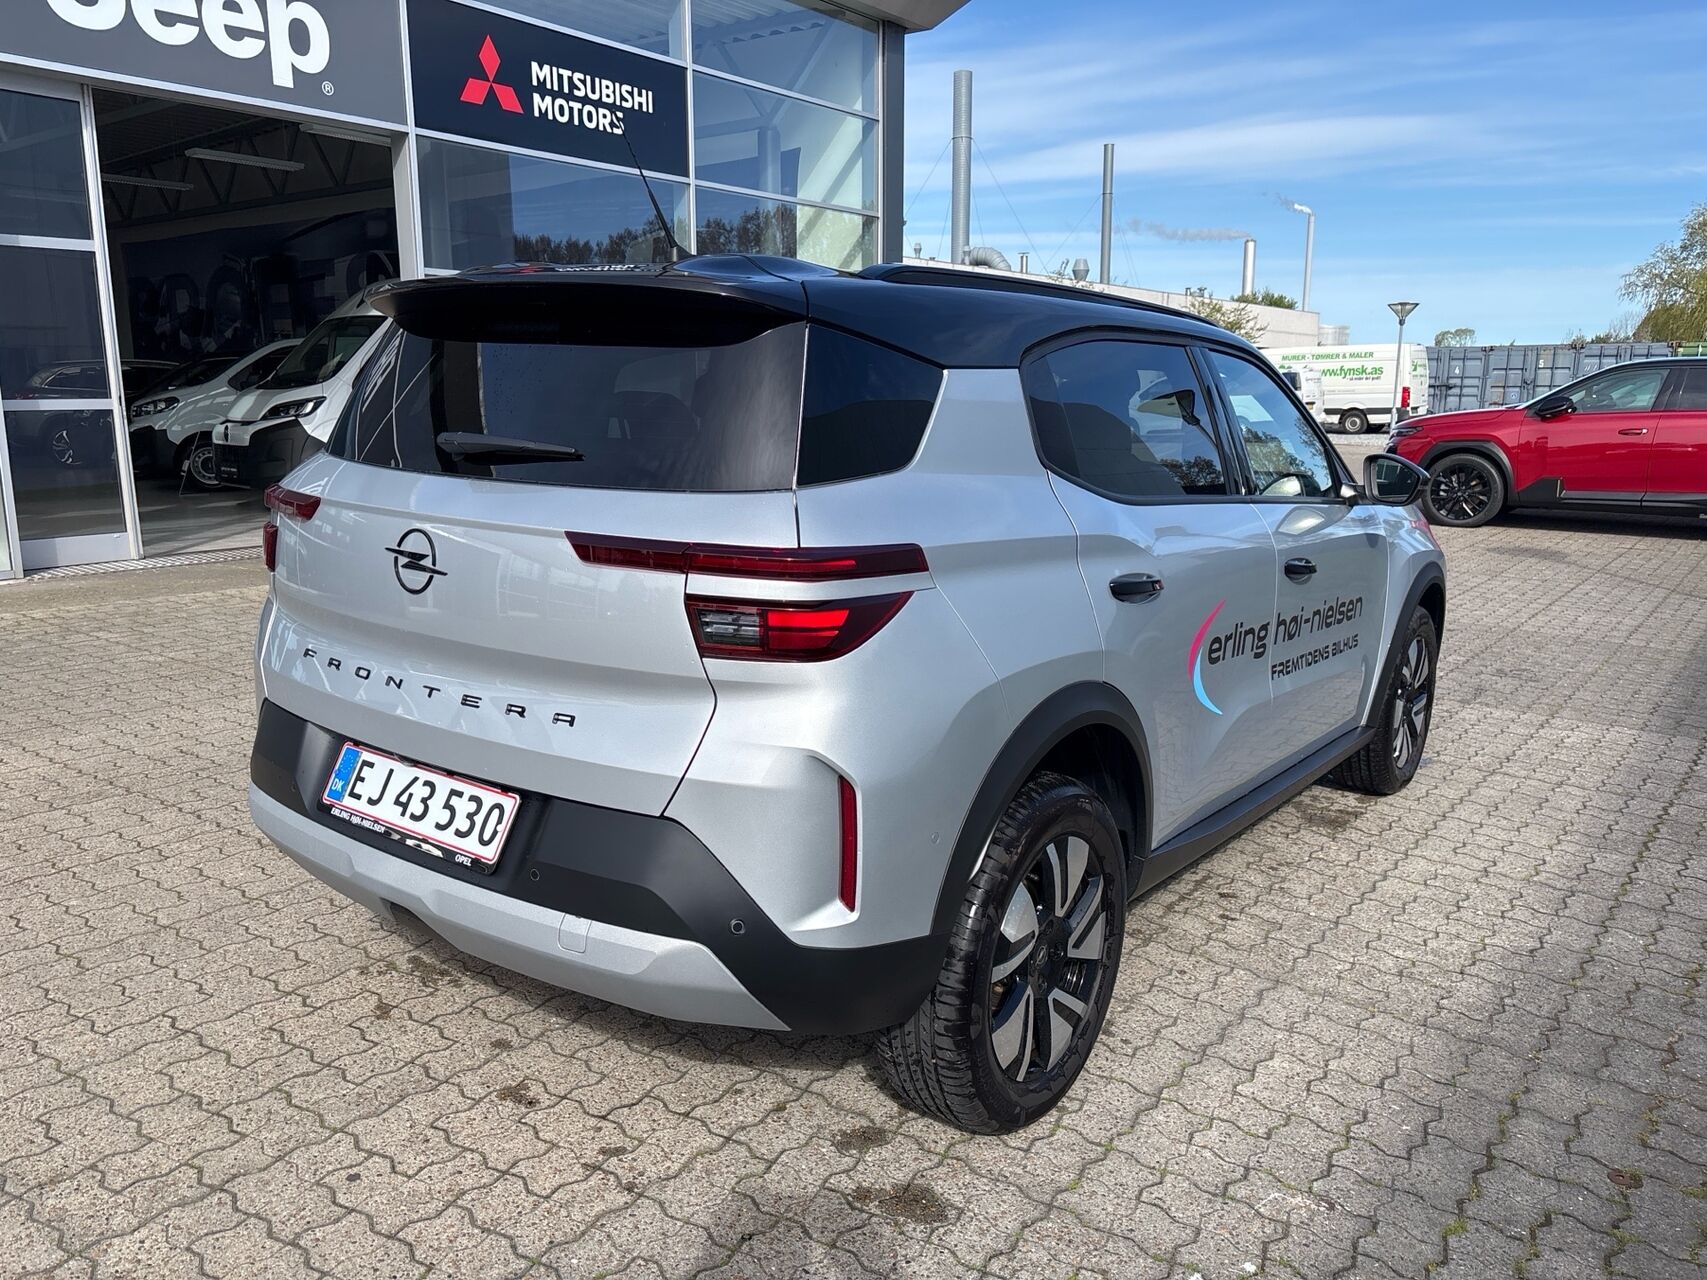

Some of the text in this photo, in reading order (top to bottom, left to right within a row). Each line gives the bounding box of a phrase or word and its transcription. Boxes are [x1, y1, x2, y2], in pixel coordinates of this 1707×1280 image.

[531, 60, 653, 114] MITSUBISHI
[532, 92, 625, 135] MOTORS
[1348, 351, 1374, 359] MALER
[1321, 364, 1384, 379] ww.fynsk.as
[1454, 366, 1460, 375] 4
[1538, 360, 1545, 368] 5
[1207, 596, 1363, 665] erling høi-nielsen
[1271, 633, 1359, 681] FREMTIDENS BILHUS
[302, 647, 576, 728] FRONTERA
[331, 778, 345, 793] DK
[347, 759, 505, 847] EJ 43 530
[330, 807, 351, 821] ERLING
[454, 854, 472, 867] OPEL
